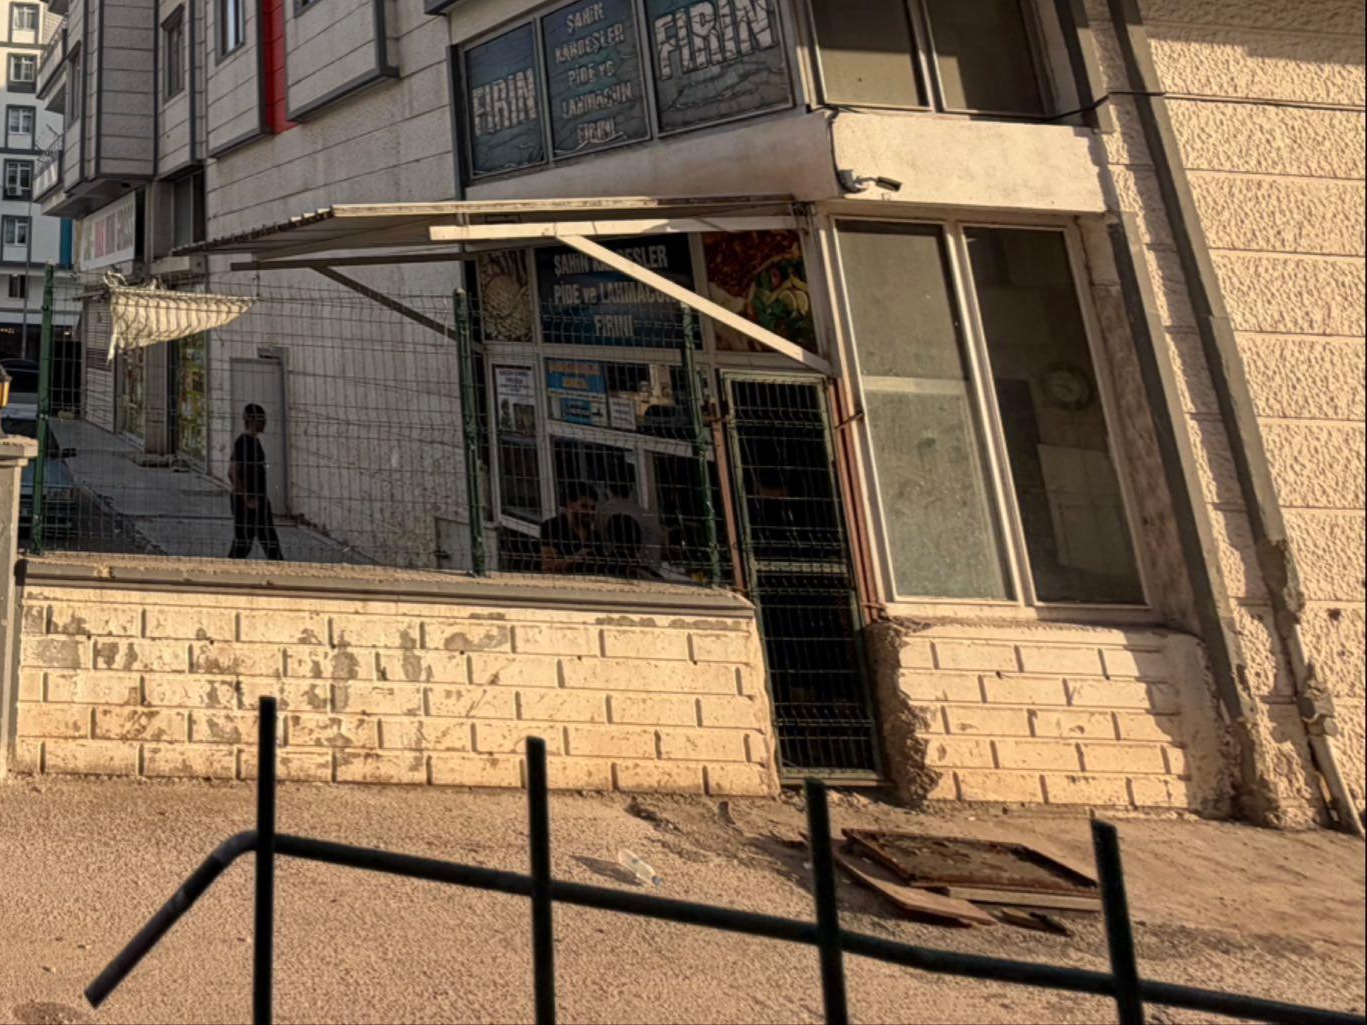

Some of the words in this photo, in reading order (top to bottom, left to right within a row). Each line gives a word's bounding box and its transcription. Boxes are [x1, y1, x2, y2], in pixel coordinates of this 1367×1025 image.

[471, 67, 537, 137] FIRIN
[562, 82, 634, 119] LAHMACUN
[553, 280, 580, 305] PİDE
[584, 287, 597, 304] ve
[600, 281, 678, 304] LAHMACU
[593, 314, 634, 337] FIRINI
